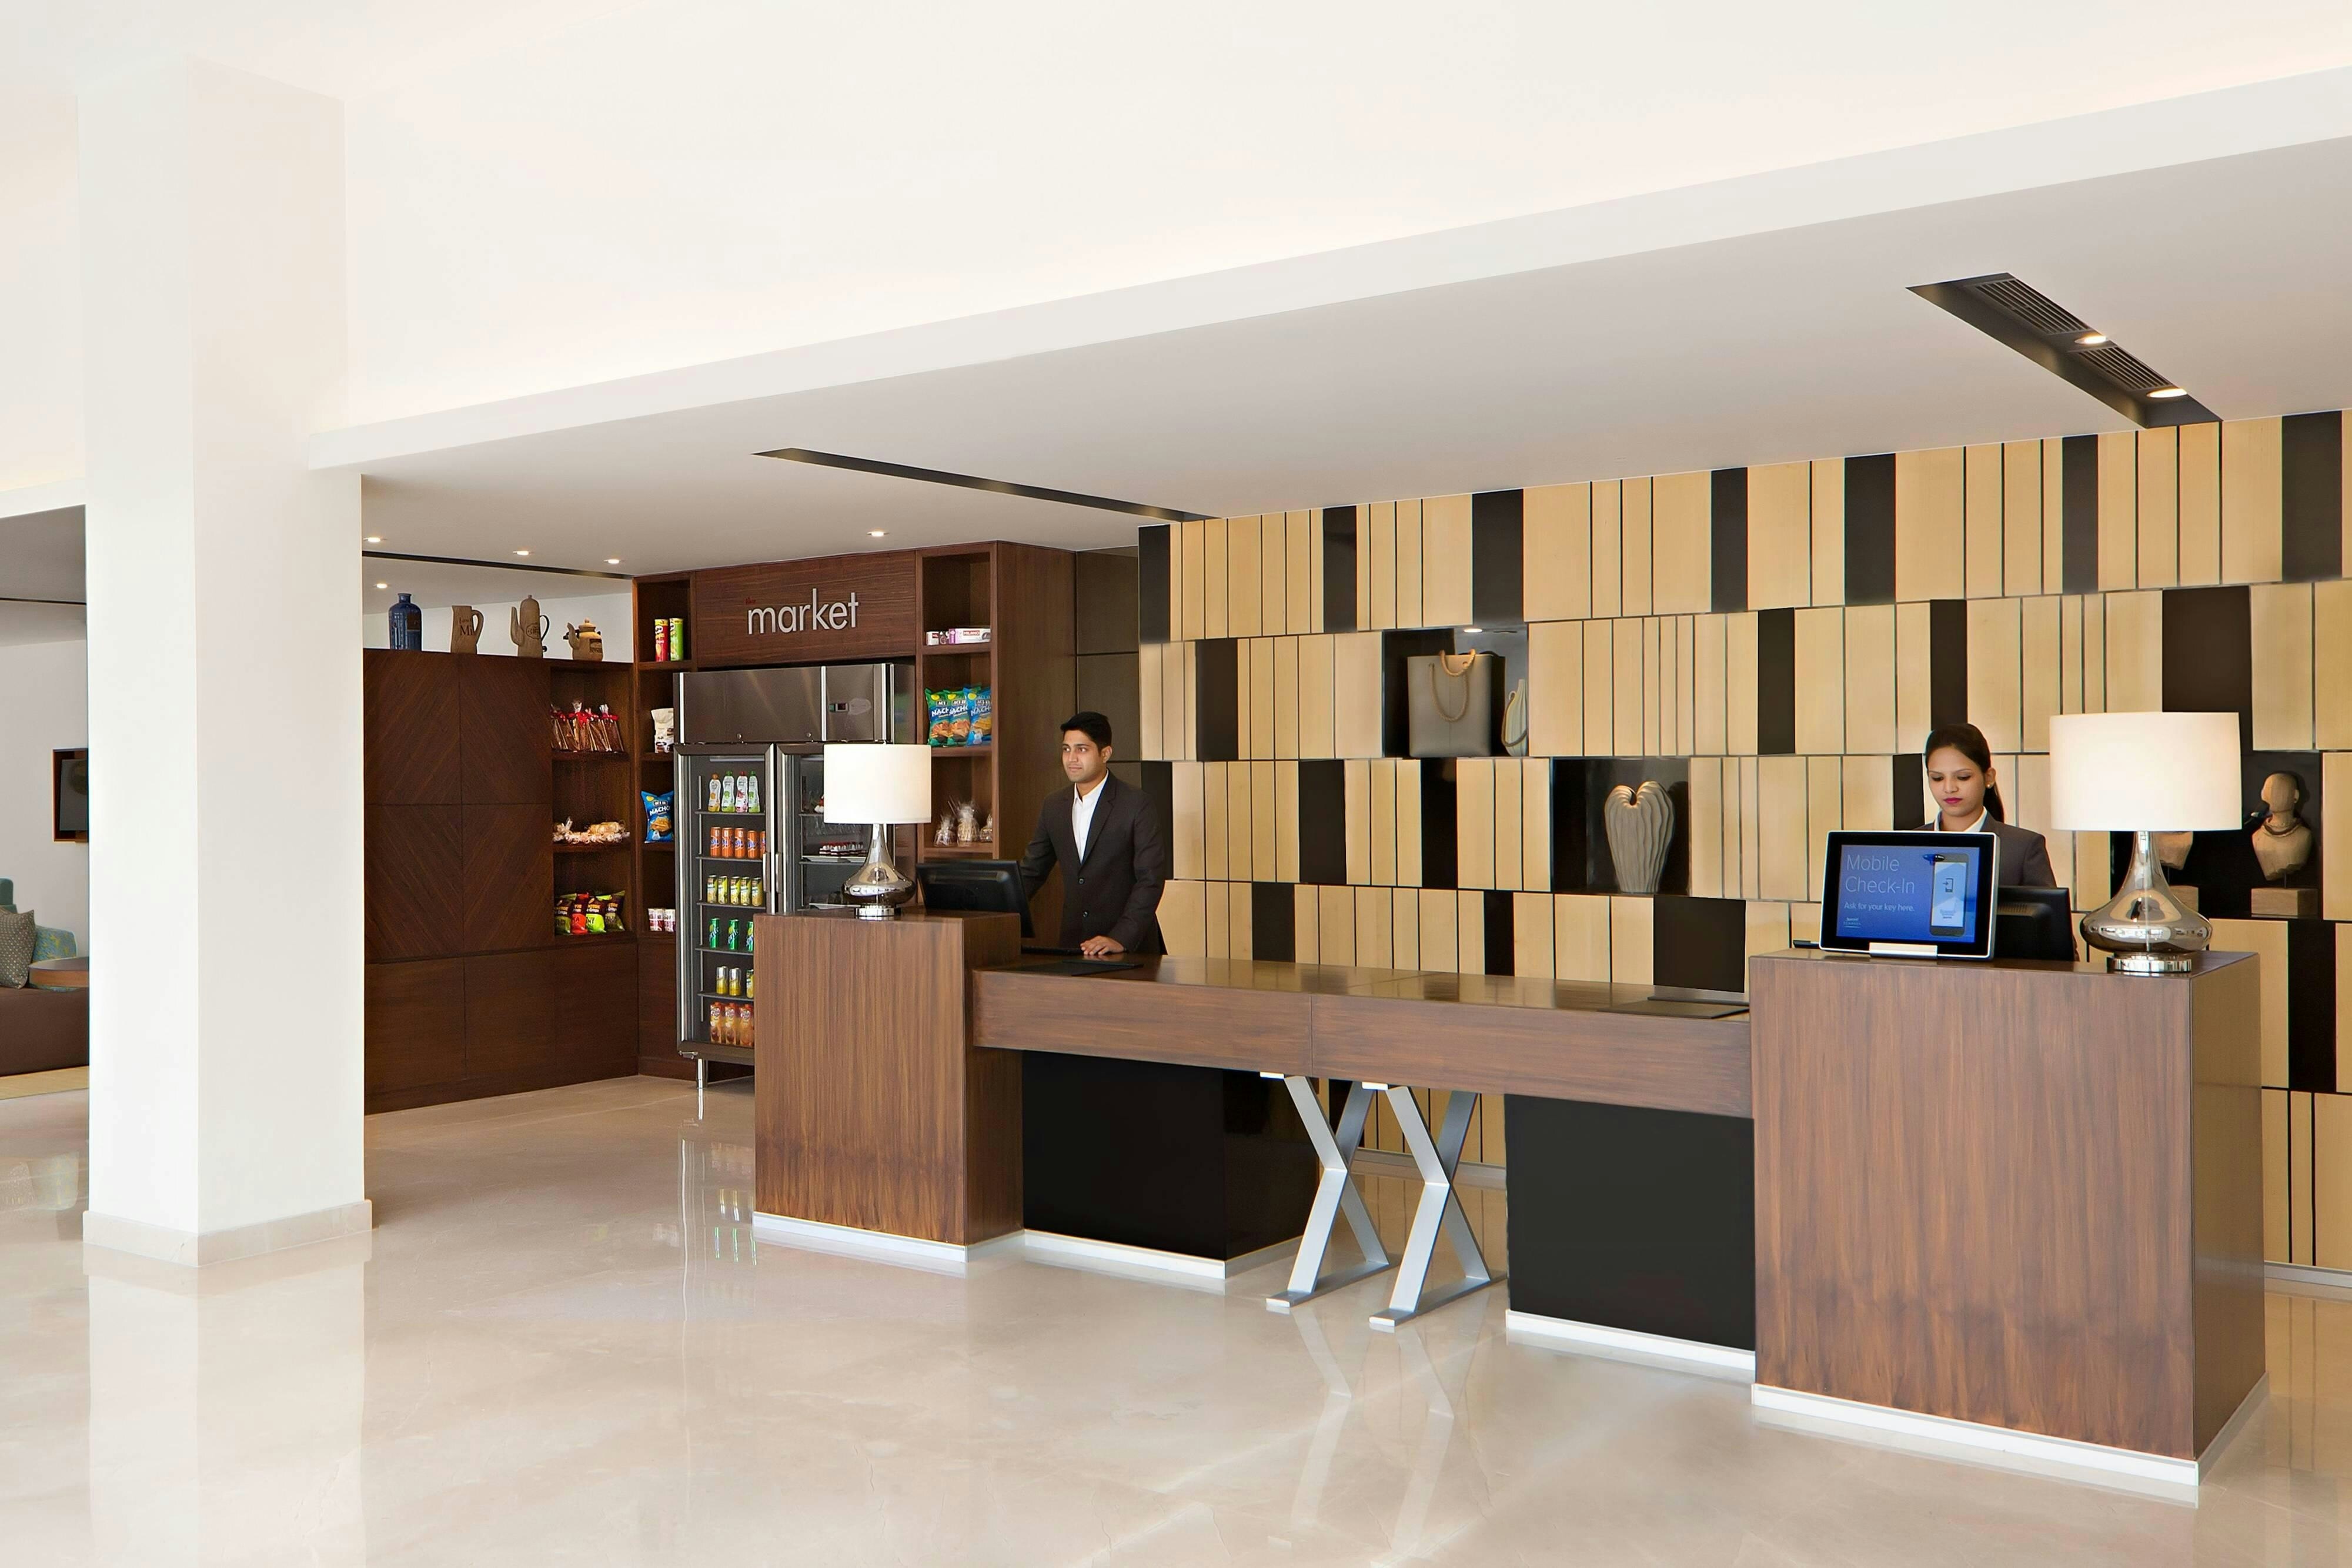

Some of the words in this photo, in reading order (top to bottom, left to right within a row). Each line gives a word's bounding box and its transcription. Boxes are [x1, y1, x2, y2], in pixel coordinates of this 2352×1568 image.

[747, 588, 859, 635] market
[1846, 854, 1900, 872] Mobile
[1845, 876, 1915, 894] Check-In
[1844, 901, 1856, 910] Ask
[1884, 902, 1896, 912] key
[1897, 903, 1915, 912] here.
